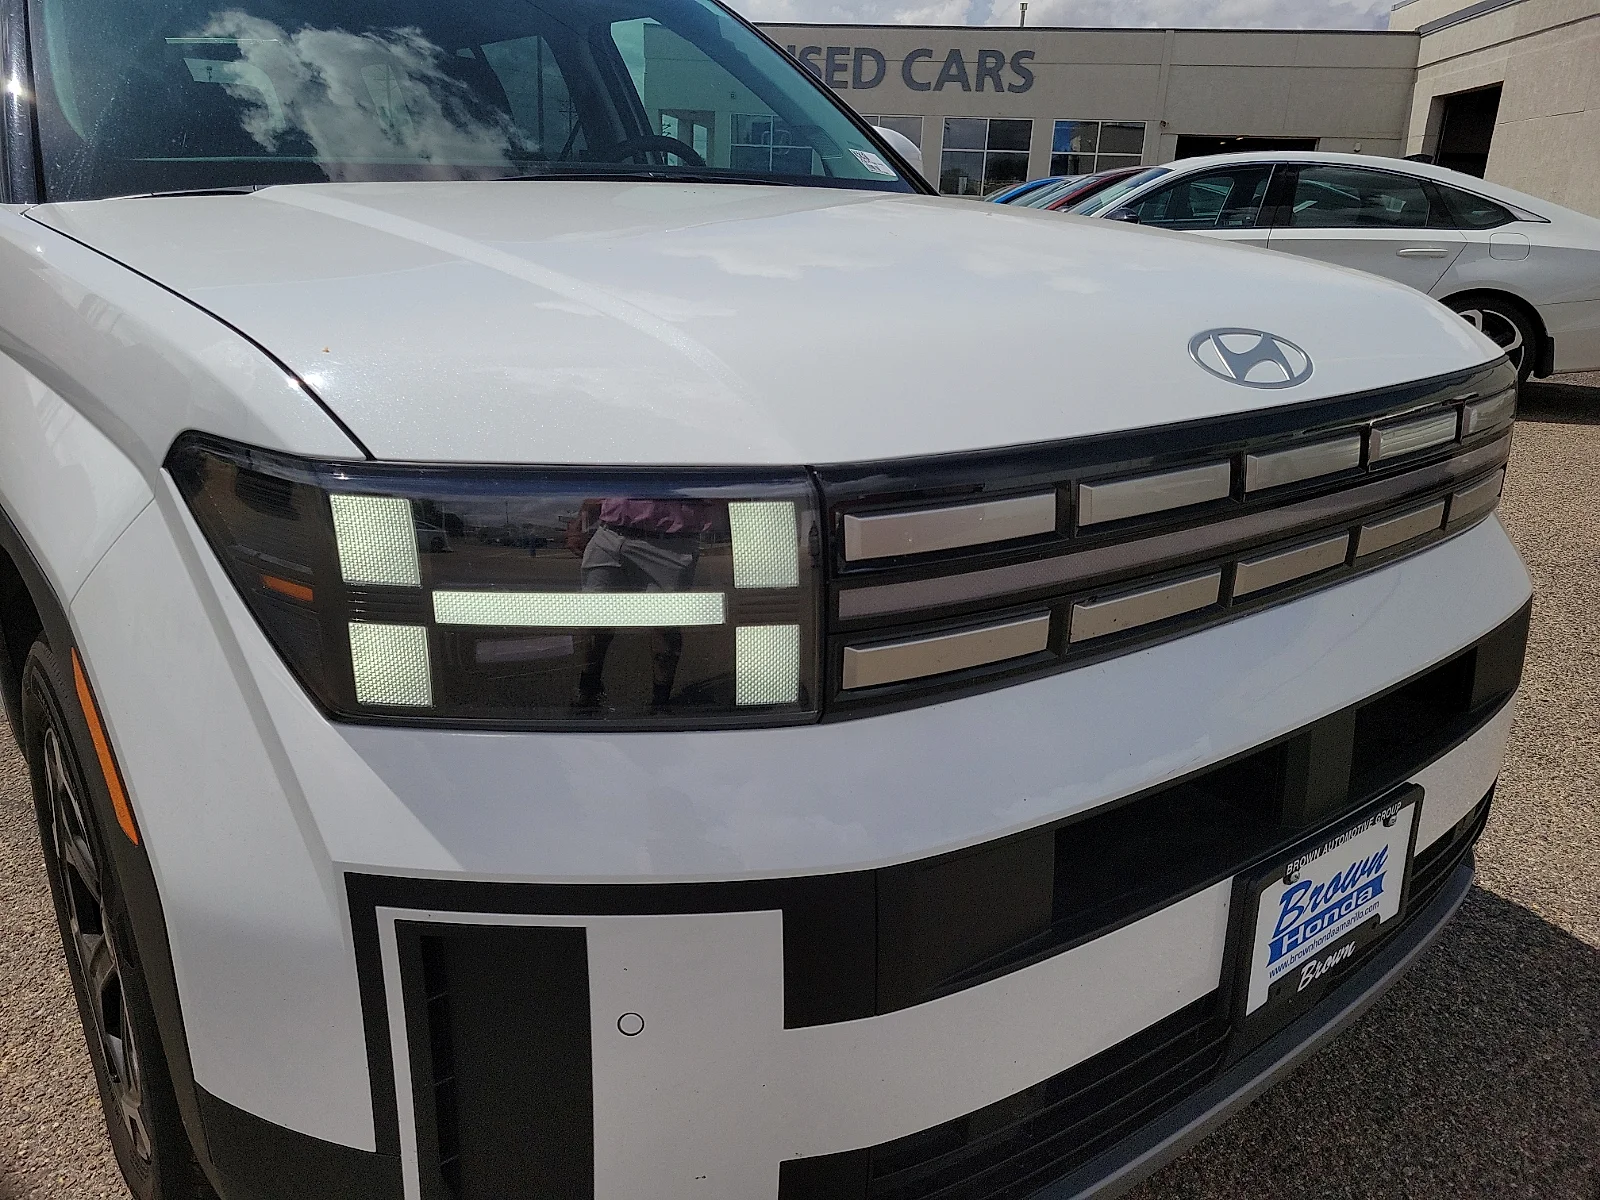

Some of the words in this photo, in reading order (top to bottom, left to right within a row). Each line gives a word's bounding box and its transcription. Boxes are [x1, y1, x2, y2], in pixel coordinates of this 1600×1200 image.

[901, 48, 1036, 93] CARS
[1286, 847, 1321, 876] BROWN
[1321, 816, 1376, 855] AUTOMOTIVE
[1375, 801, 1402, 824] GROUP
[1271, 843, 1389, 940] Brown
[1281, 885, 1373, 956] Honda
[1268, 900, 1380, 979] www.brownhondaamarillo.com
[1297, 941, 1357, 993] Brown
